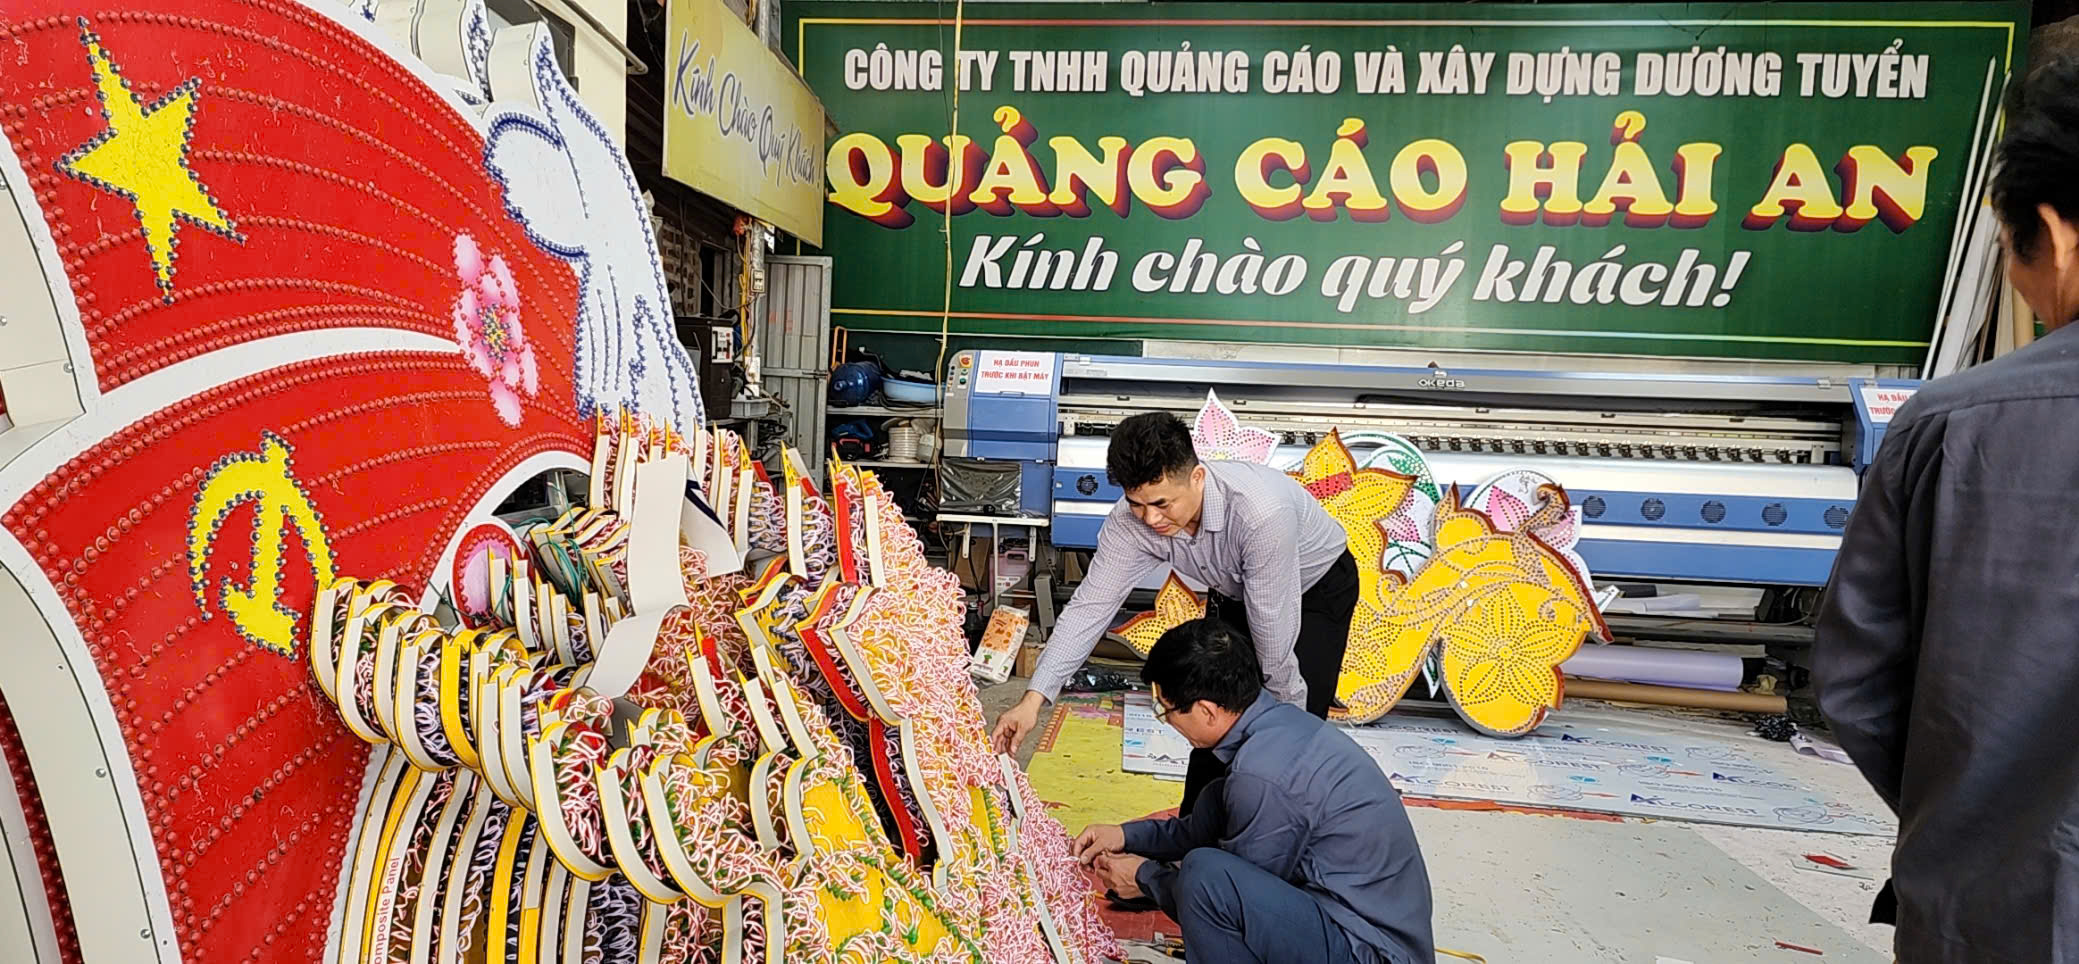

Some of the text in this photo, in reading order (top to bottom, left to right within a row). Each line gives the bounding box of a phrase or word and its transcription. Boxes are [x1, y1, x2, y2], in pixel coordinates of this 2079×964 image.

[844, 38, 1930, 104] CÔNG TY TNHH QUẢNG CÁO VÀ XÂY DỰNG DƯƠNG TUYỂN
[673, 29, 716, 116] Kính
[718, 72, 758, 143] Chào
[758, 104, 786, 188] Quý
[826, 106, 1938, 233] QUẢNG CÁO HẢI AN
[958, 231, 1752, 313] Kính chào quý khách!
[1005, 371, 1017, 380] KHI
[381, 857, 401, 895] Panel
